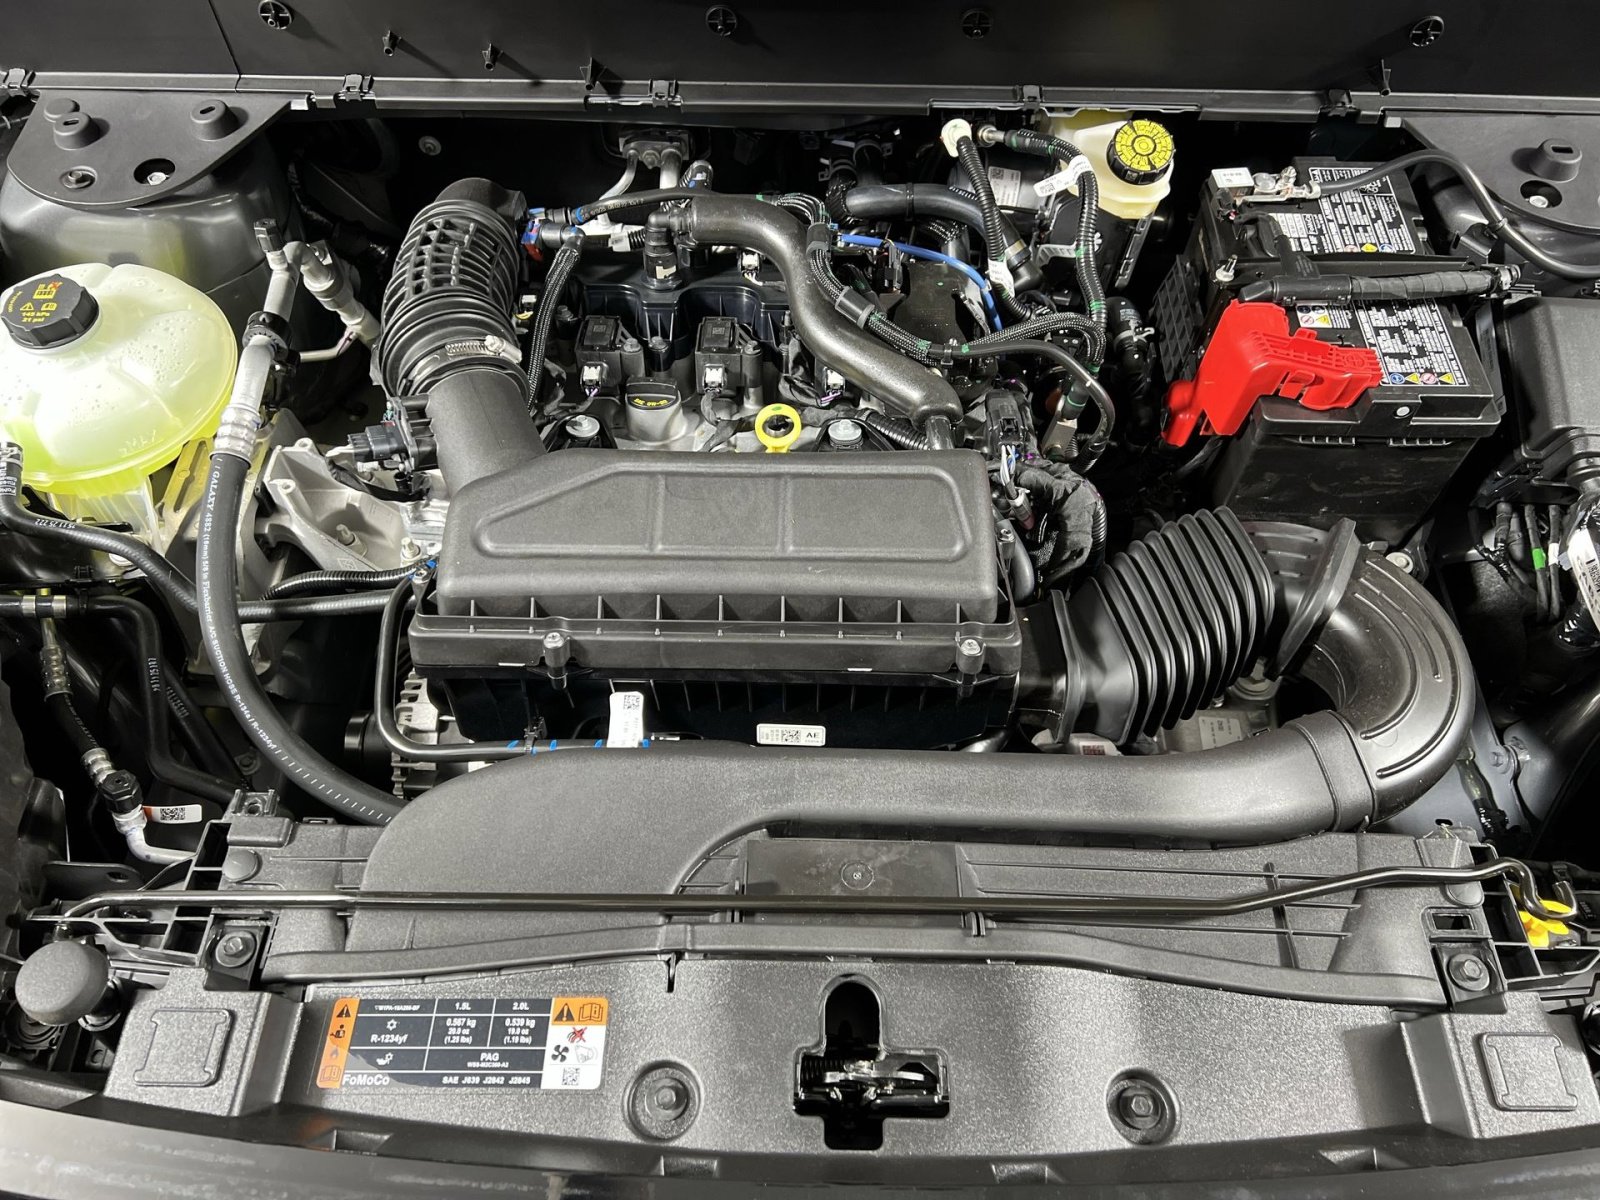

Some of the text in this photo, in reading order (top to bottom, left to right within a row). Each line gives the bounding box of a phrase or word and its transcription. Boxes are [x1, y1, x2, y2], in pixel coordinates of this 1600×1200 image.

[207, 471, 220, 511] GALAXY
[204, 512, 213, 532] 4882
[212, 640, 228, 673] SUCTION
[224, 672, 238, 694] HOSE
[234, 693, 251, 719] R-134a
[251, 721, 278, 750] R-1234yf
[455, 1002, 471, 1010] 1.5L
[512, 1002, 529, 1010] 2.0L
[466, 1018, 477, 1029] kg
[505, 1018, 536, 1029] 0.539 kg
[370, 1034, 408, 1045] R-1234yf
[460, 1036, 472, 1044] lbs)
[520, 1036, 532, 1044] lbs)
[480, 1052, 499, 1061] PAG
[342, 1074, 390, 1086] FoMoCo
[442, 1076, 459, 1084] SAE
[461, 1076, 480, 1084] J639
